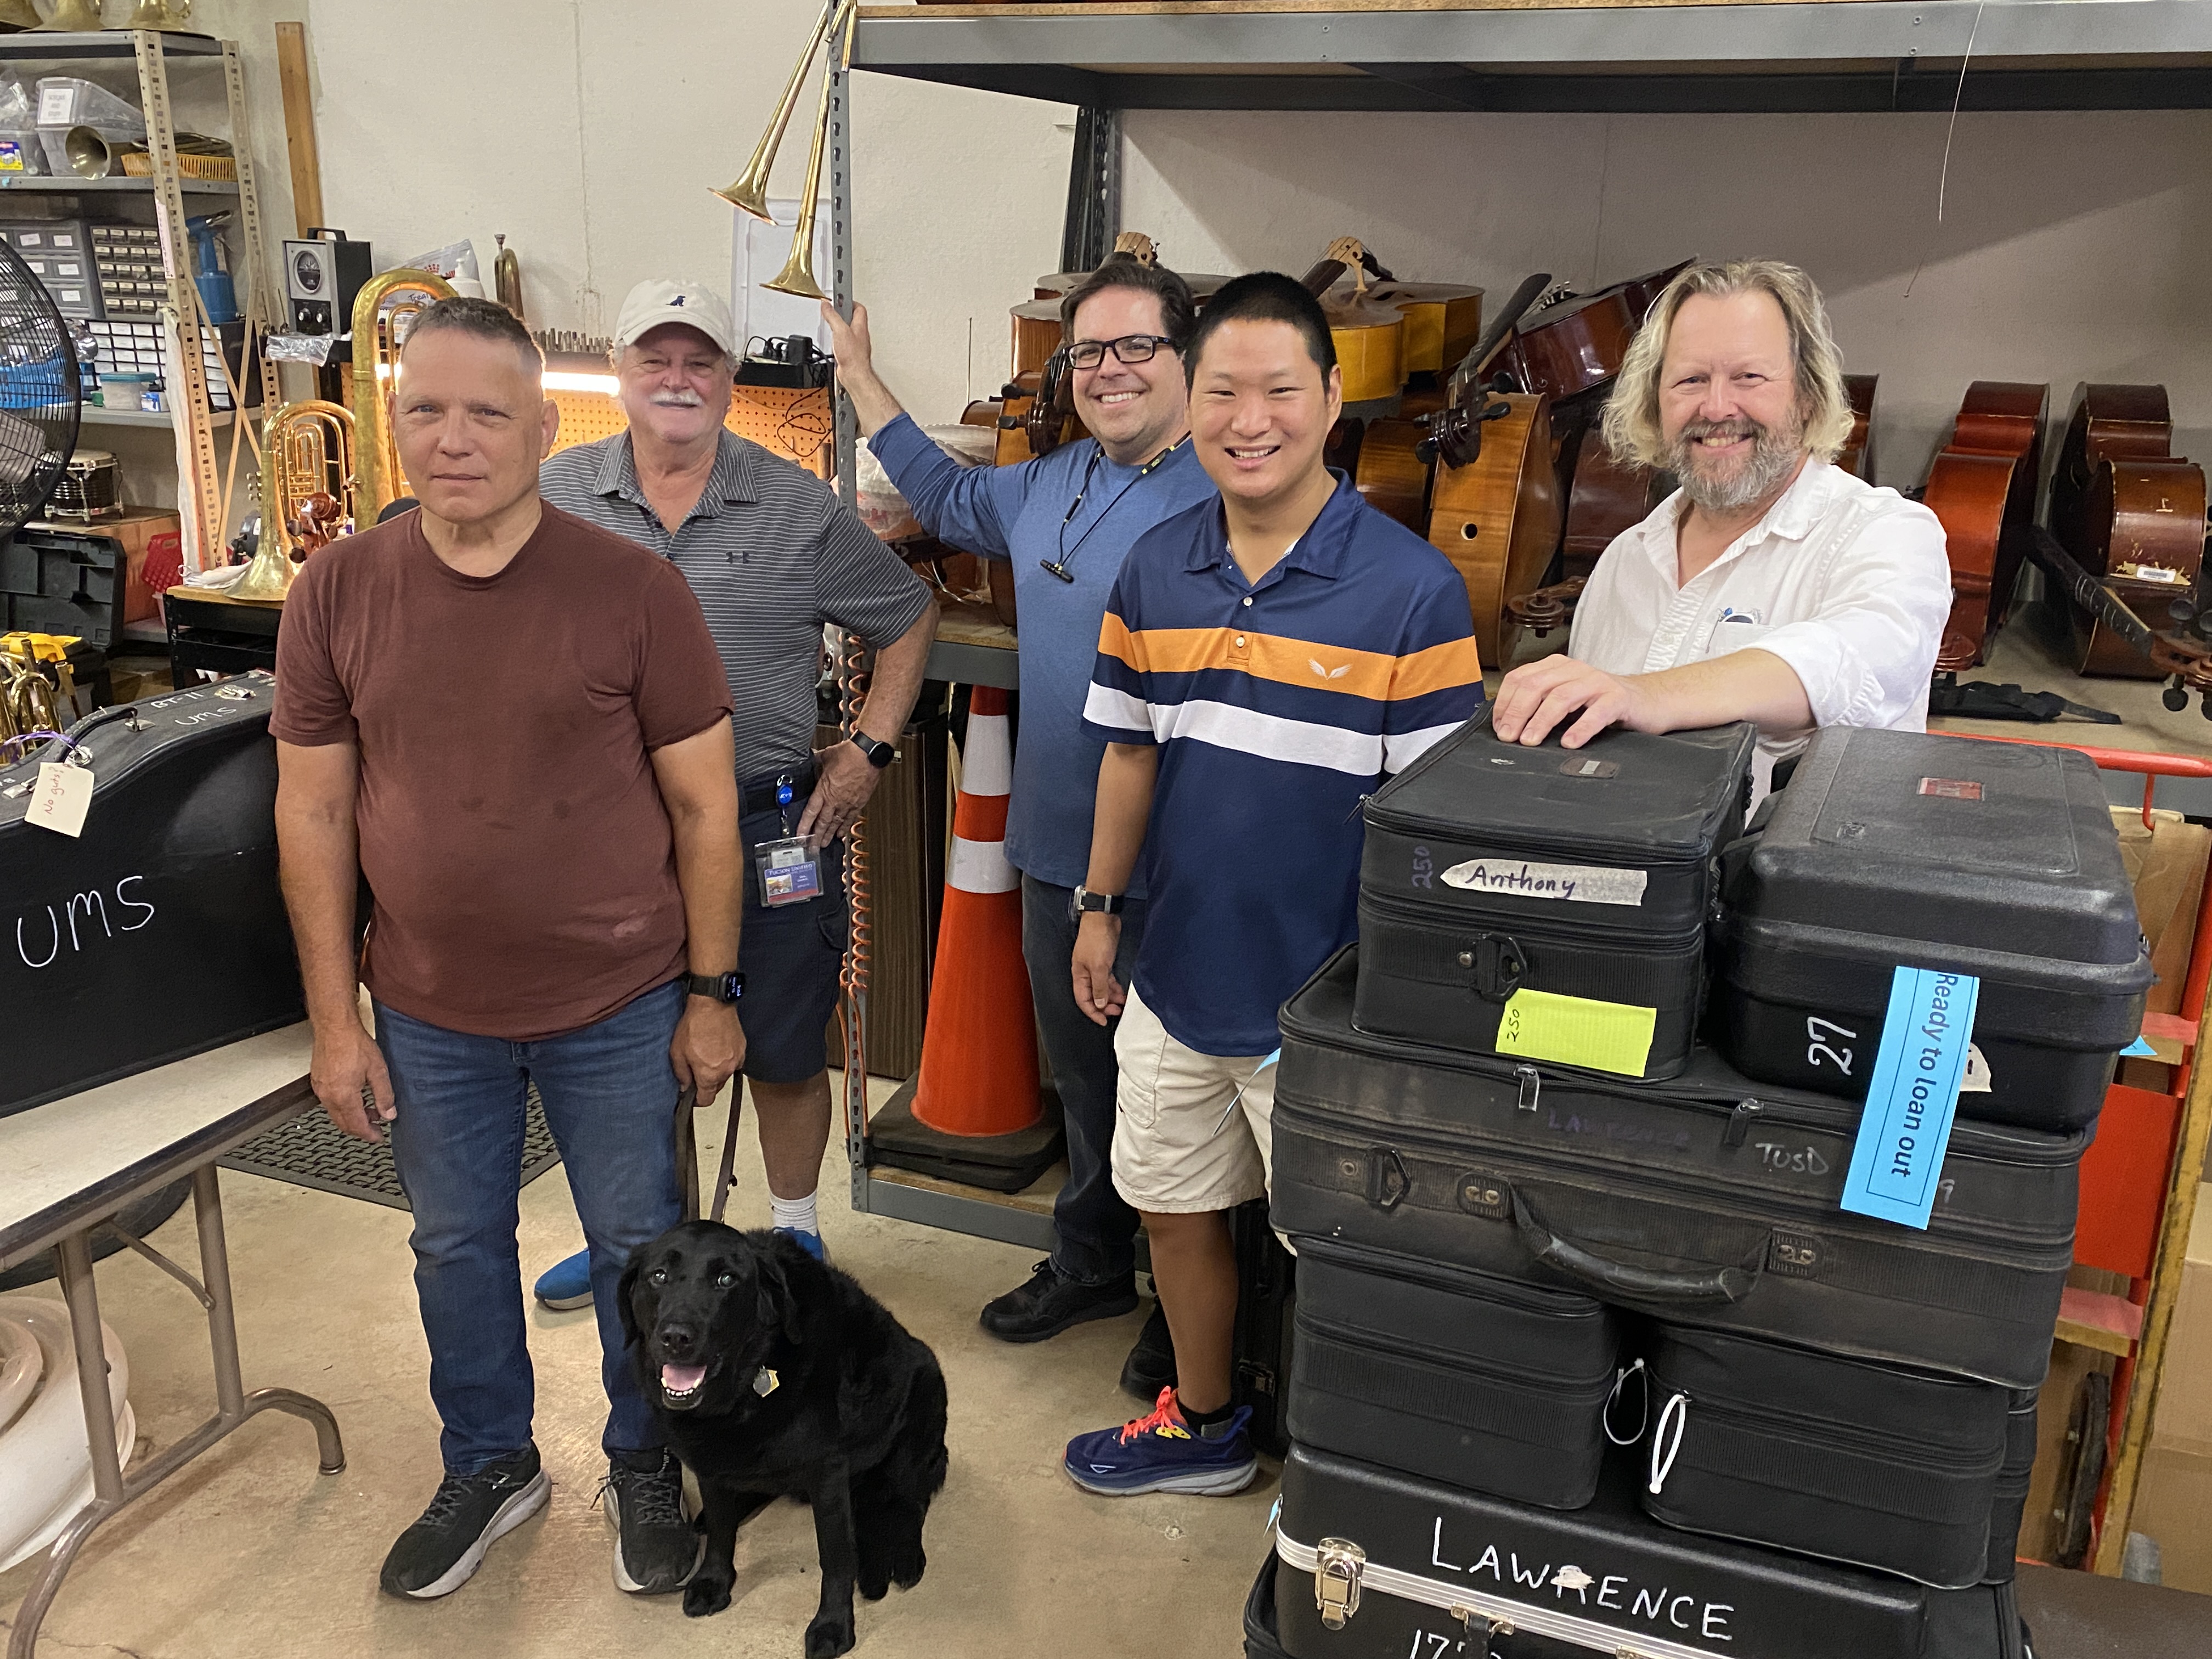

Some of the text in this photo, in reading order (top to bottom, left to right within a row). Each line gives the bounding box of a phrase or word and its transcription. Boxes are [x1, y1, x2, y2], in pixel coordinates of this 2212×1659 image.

[43, 799, 54, 815] No
[1411, 845, 1434, 889] 250
[1465, 864, 1576, 900] Anthony
[17, 876, 154, 967] UMS
[1506, 1008, 1520, 1042] 250
[1807, 1017, 1857, 1075] 27
[1891, 973, 1959, 1178] Ready to loan out
[1755, 1143, 1829, 1175] TUSD
[1432, 1516, 1735, 1640] LAWRENCE
